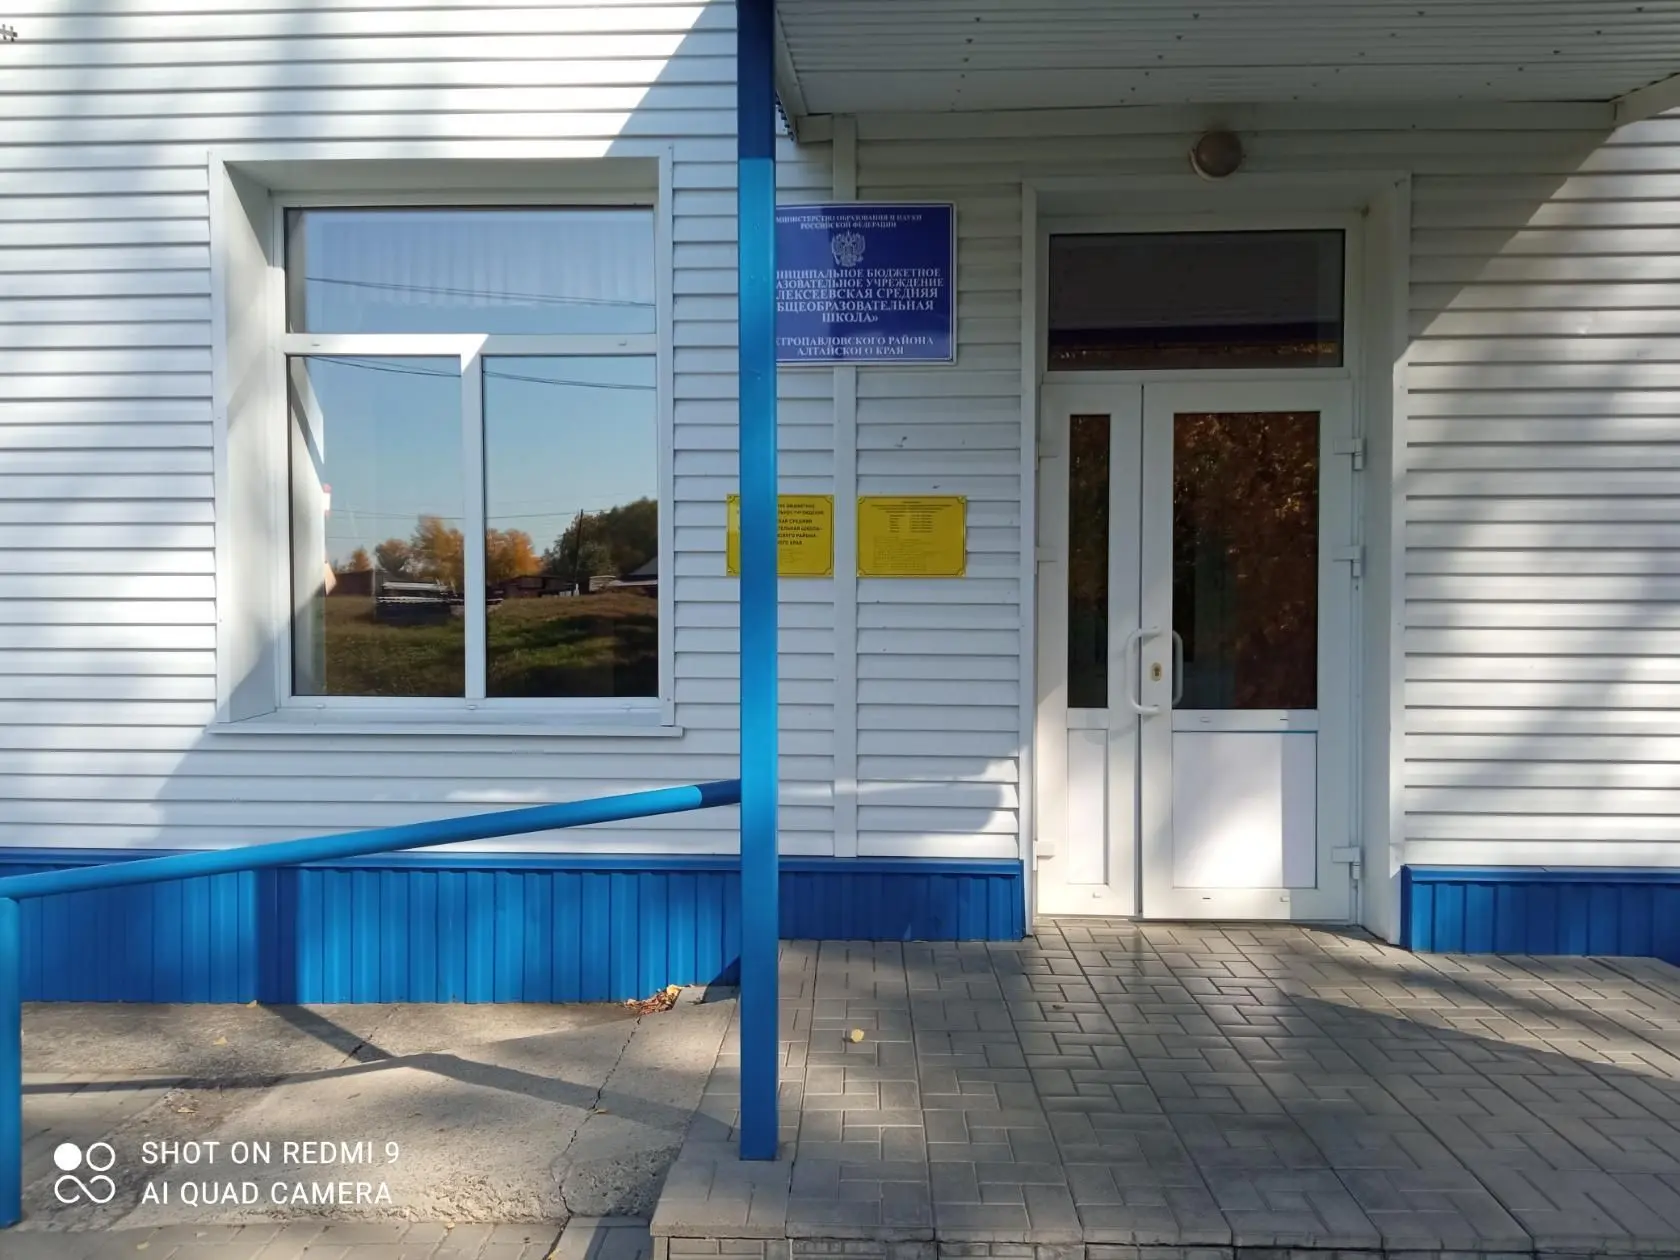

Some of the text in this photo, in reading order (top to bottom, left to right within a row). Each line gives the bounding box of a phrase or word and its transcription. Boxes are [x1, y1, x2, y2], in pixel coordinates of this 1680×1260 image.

[836, 214, 888, 222] ОБРАЗОВАНИЯ
[897, 214, 922, 222] НАУКИ
[801, 221, 897, 230] РОССИЙСКОЙ ФЕДЕРАЦИИ
[776, 268, 941, 280] НИЦИПАЛЬНОЕ БЮДЖЕТНОЕ
[776, 278, 944, 289] АЗОВАТЕЛЬНОЕ УЧРЕЖДЕНИЕ
[776, 287, 938, 300] ЛЕКСЕЕВСКАЯ СРЕДНЯЯ
[777, 300, 934, 314] БЩЕОБРАЗОВАТЕЛЬНАЯ
[822, 312, 878, 323] ШКОЛА»
[889, 334, 934, 345] РАЙОНА
[797, 345, 904, 356] АЛТАЙСКОГО КРАЯ
